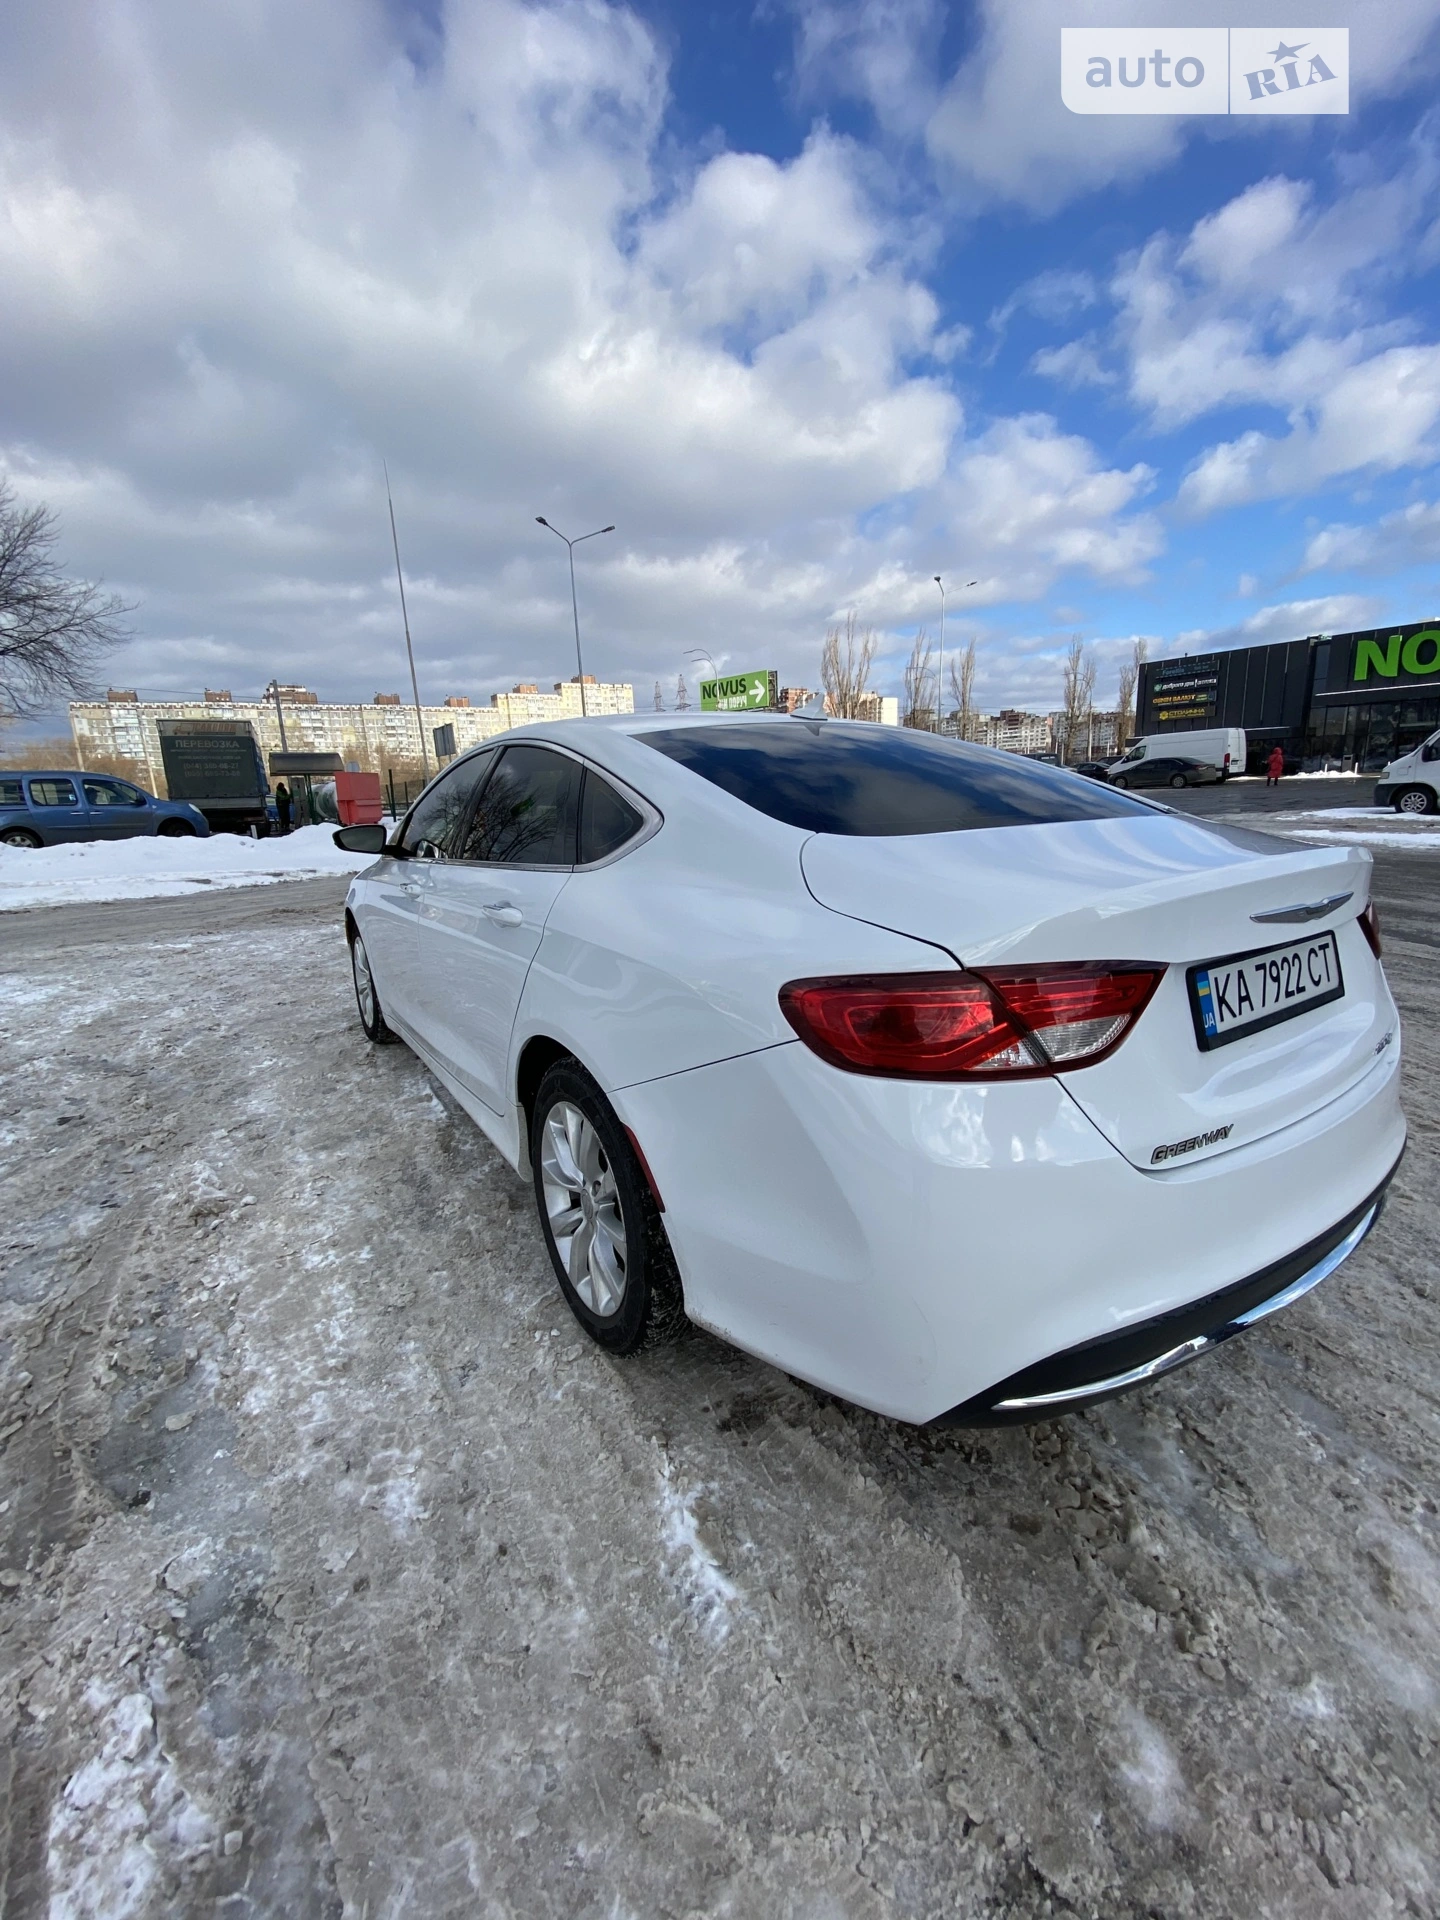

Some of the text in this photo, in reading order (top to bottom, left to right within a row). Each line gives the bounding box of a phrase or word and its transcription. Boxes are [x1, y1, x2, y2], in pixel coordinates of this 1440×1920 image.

[702, 677, 747, 700] NOVUS
[175, 739, 240, 748] ПЕРЕВОЗКА
[1214, 942, 1330, 1023] KA 7922 CT
[1203, 1012, 1215, 1029] UA
[1150, 1123, 1234, 1165] GREENWAY
